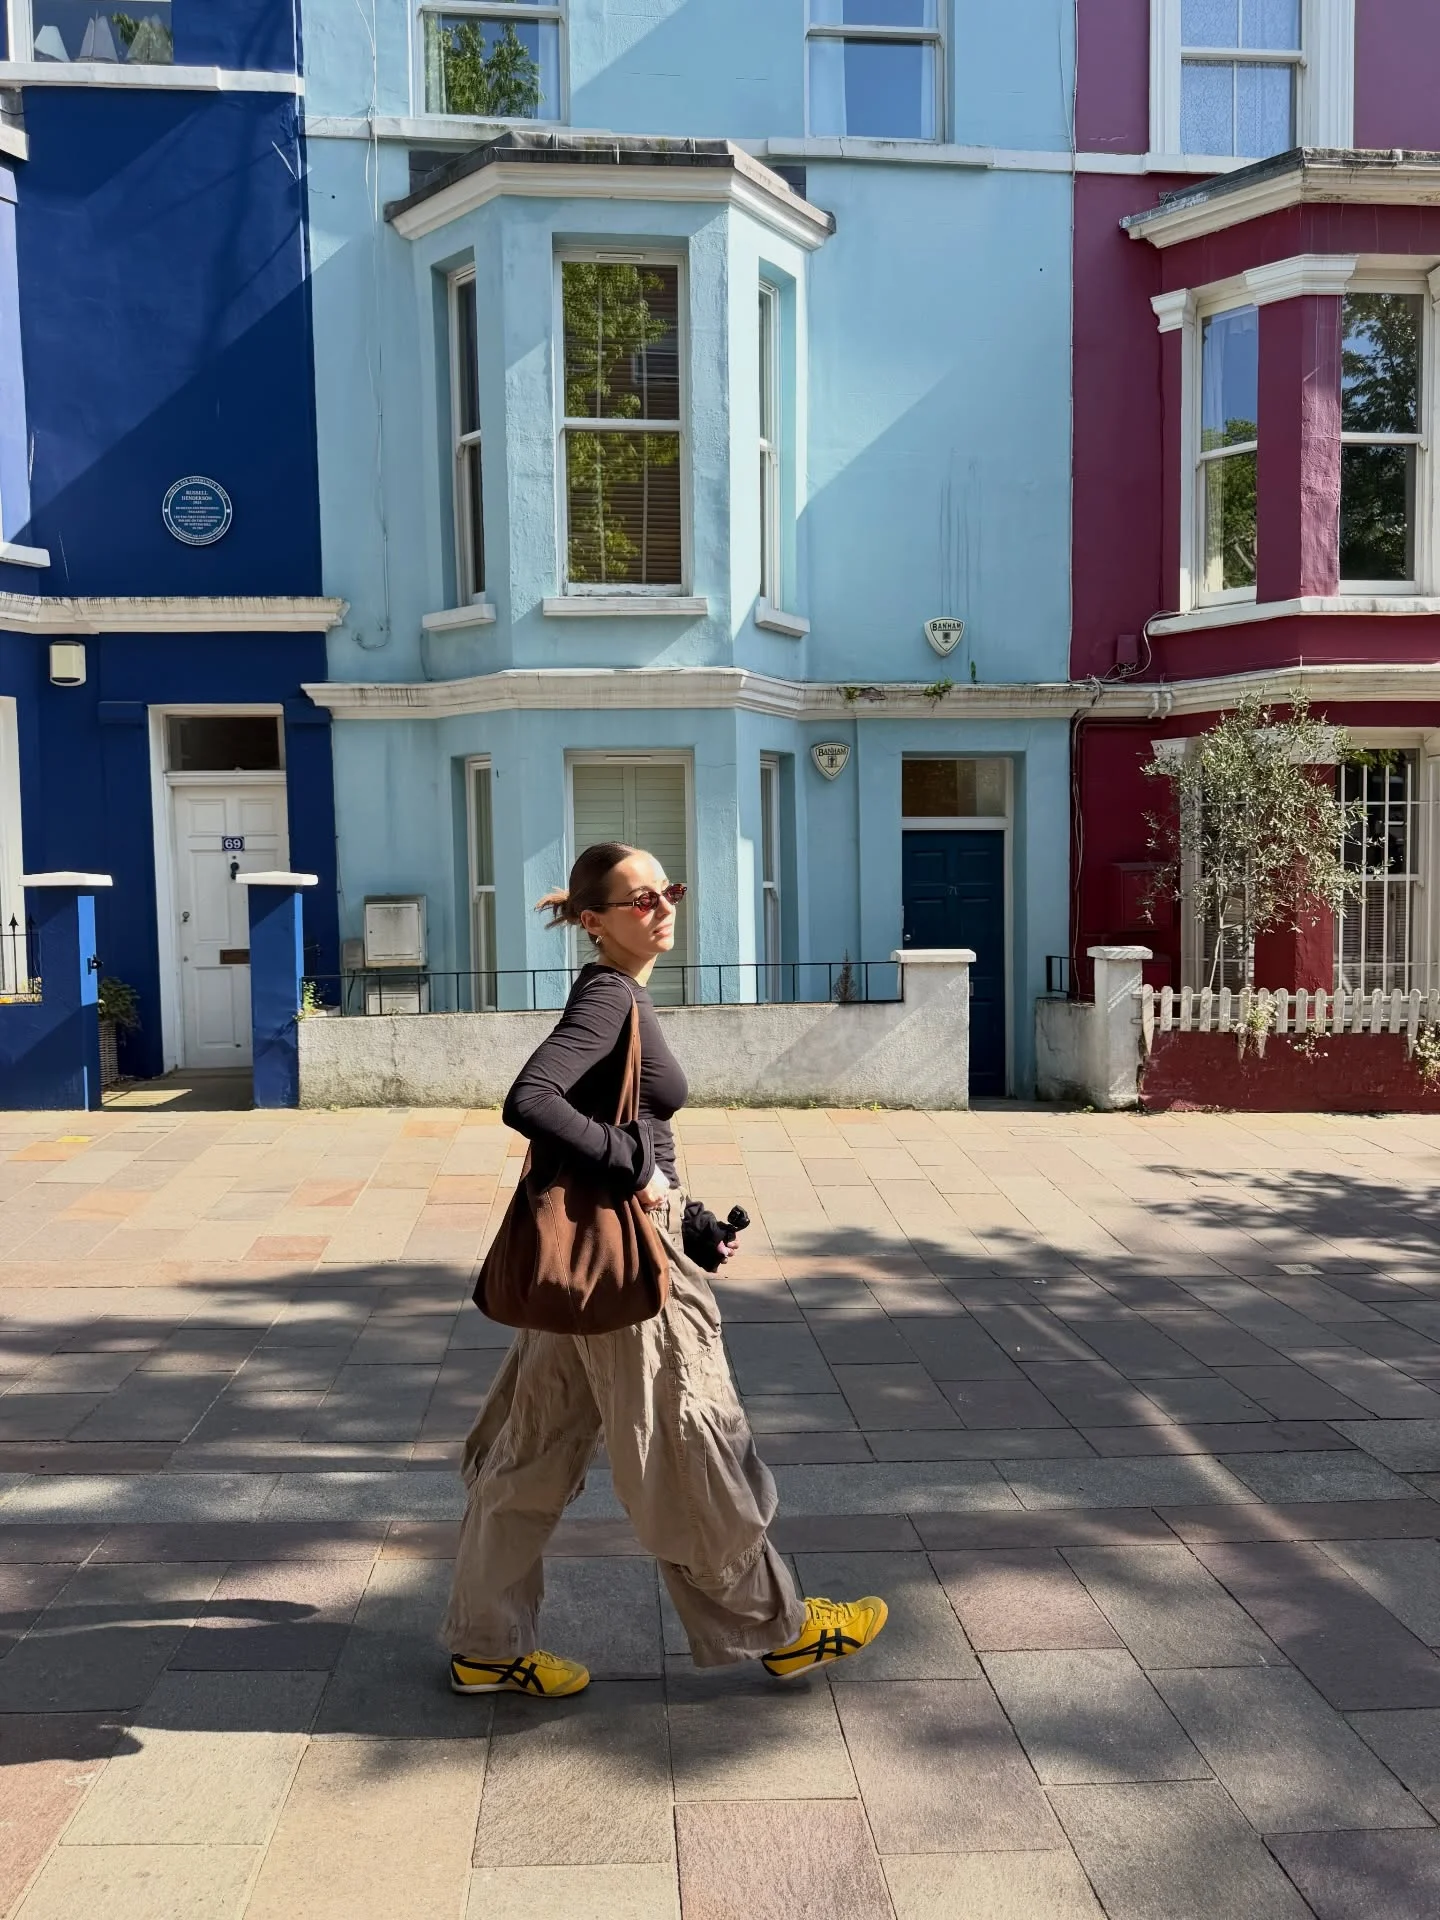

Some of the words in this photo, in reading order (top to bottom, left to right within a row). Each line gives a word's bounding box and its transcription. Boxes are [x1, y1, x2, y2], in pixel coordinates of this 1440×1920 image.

[932, 622, 962, 631] BANHAM
[818, 747, 847, 756] BANHAM
[224, 838, 242, 849] 69
